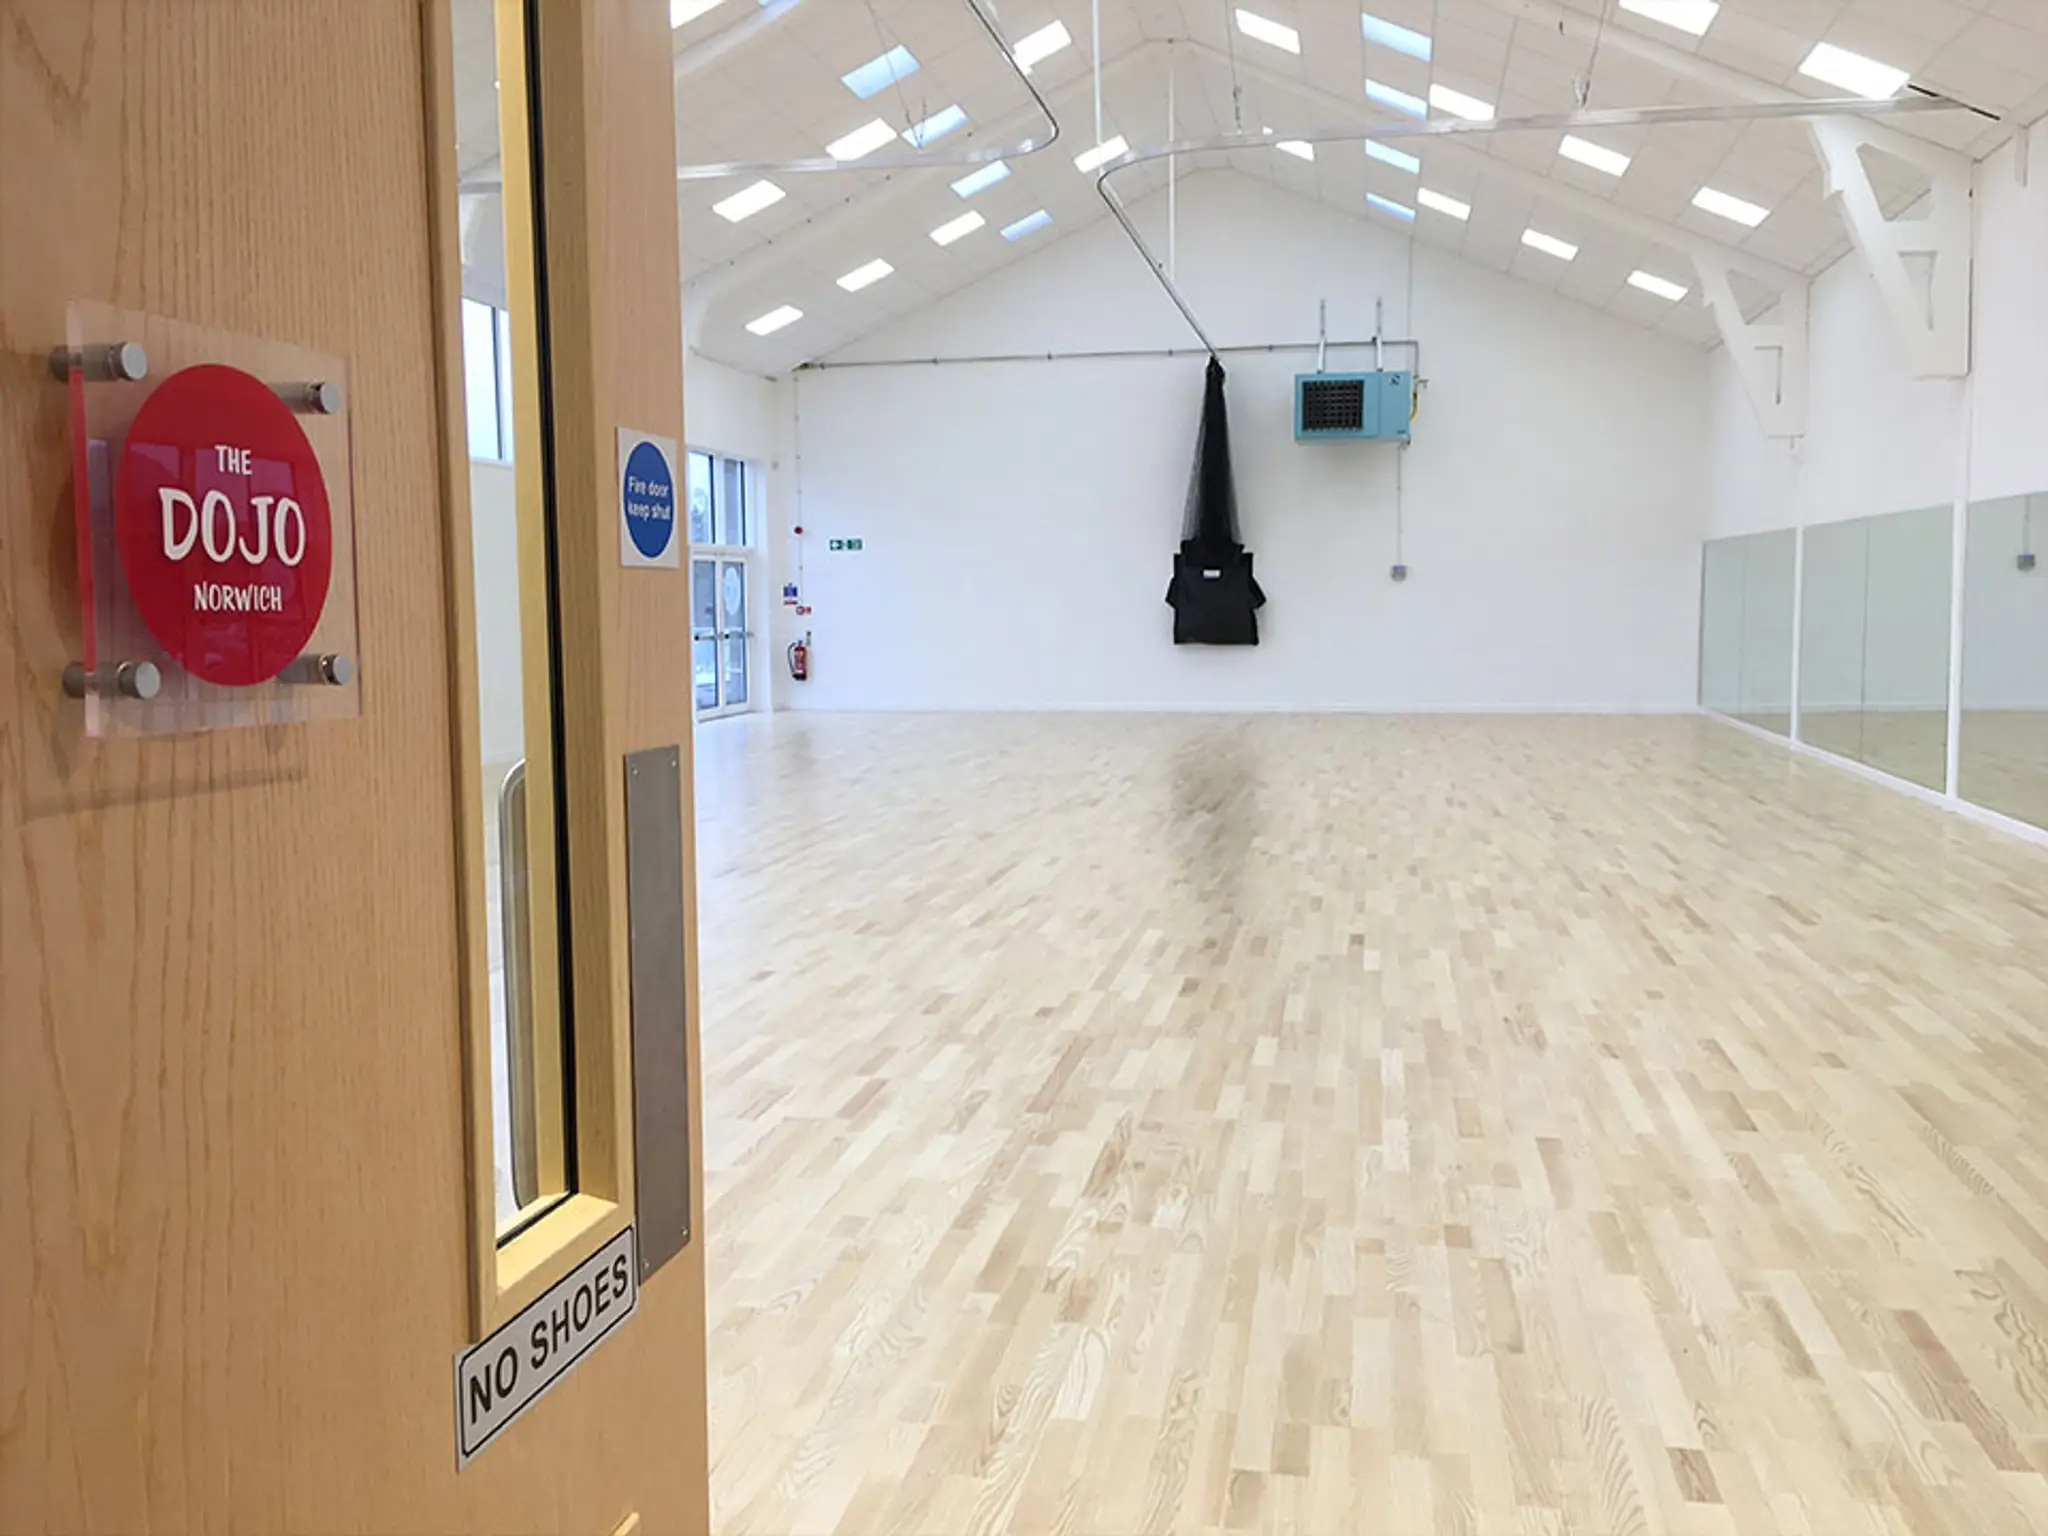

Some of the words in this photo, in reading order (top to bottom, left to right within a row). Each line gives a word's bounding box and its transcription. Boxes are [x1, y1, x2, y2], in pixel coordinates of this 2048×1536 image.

[215, 444, 253, 475] THE
[628, 475, 646, 496] Fire
[648, 480, 669, 497] door
[627, 499, 649, 521] keep
[651, 502, 671, 520] shut
[157, 487, 306, 566] DOJO
[194, 581, 283, 612] NORWICH
[469, 1346, 519, 1425] NO
[530, 1253, 628, 1369] SHOES
